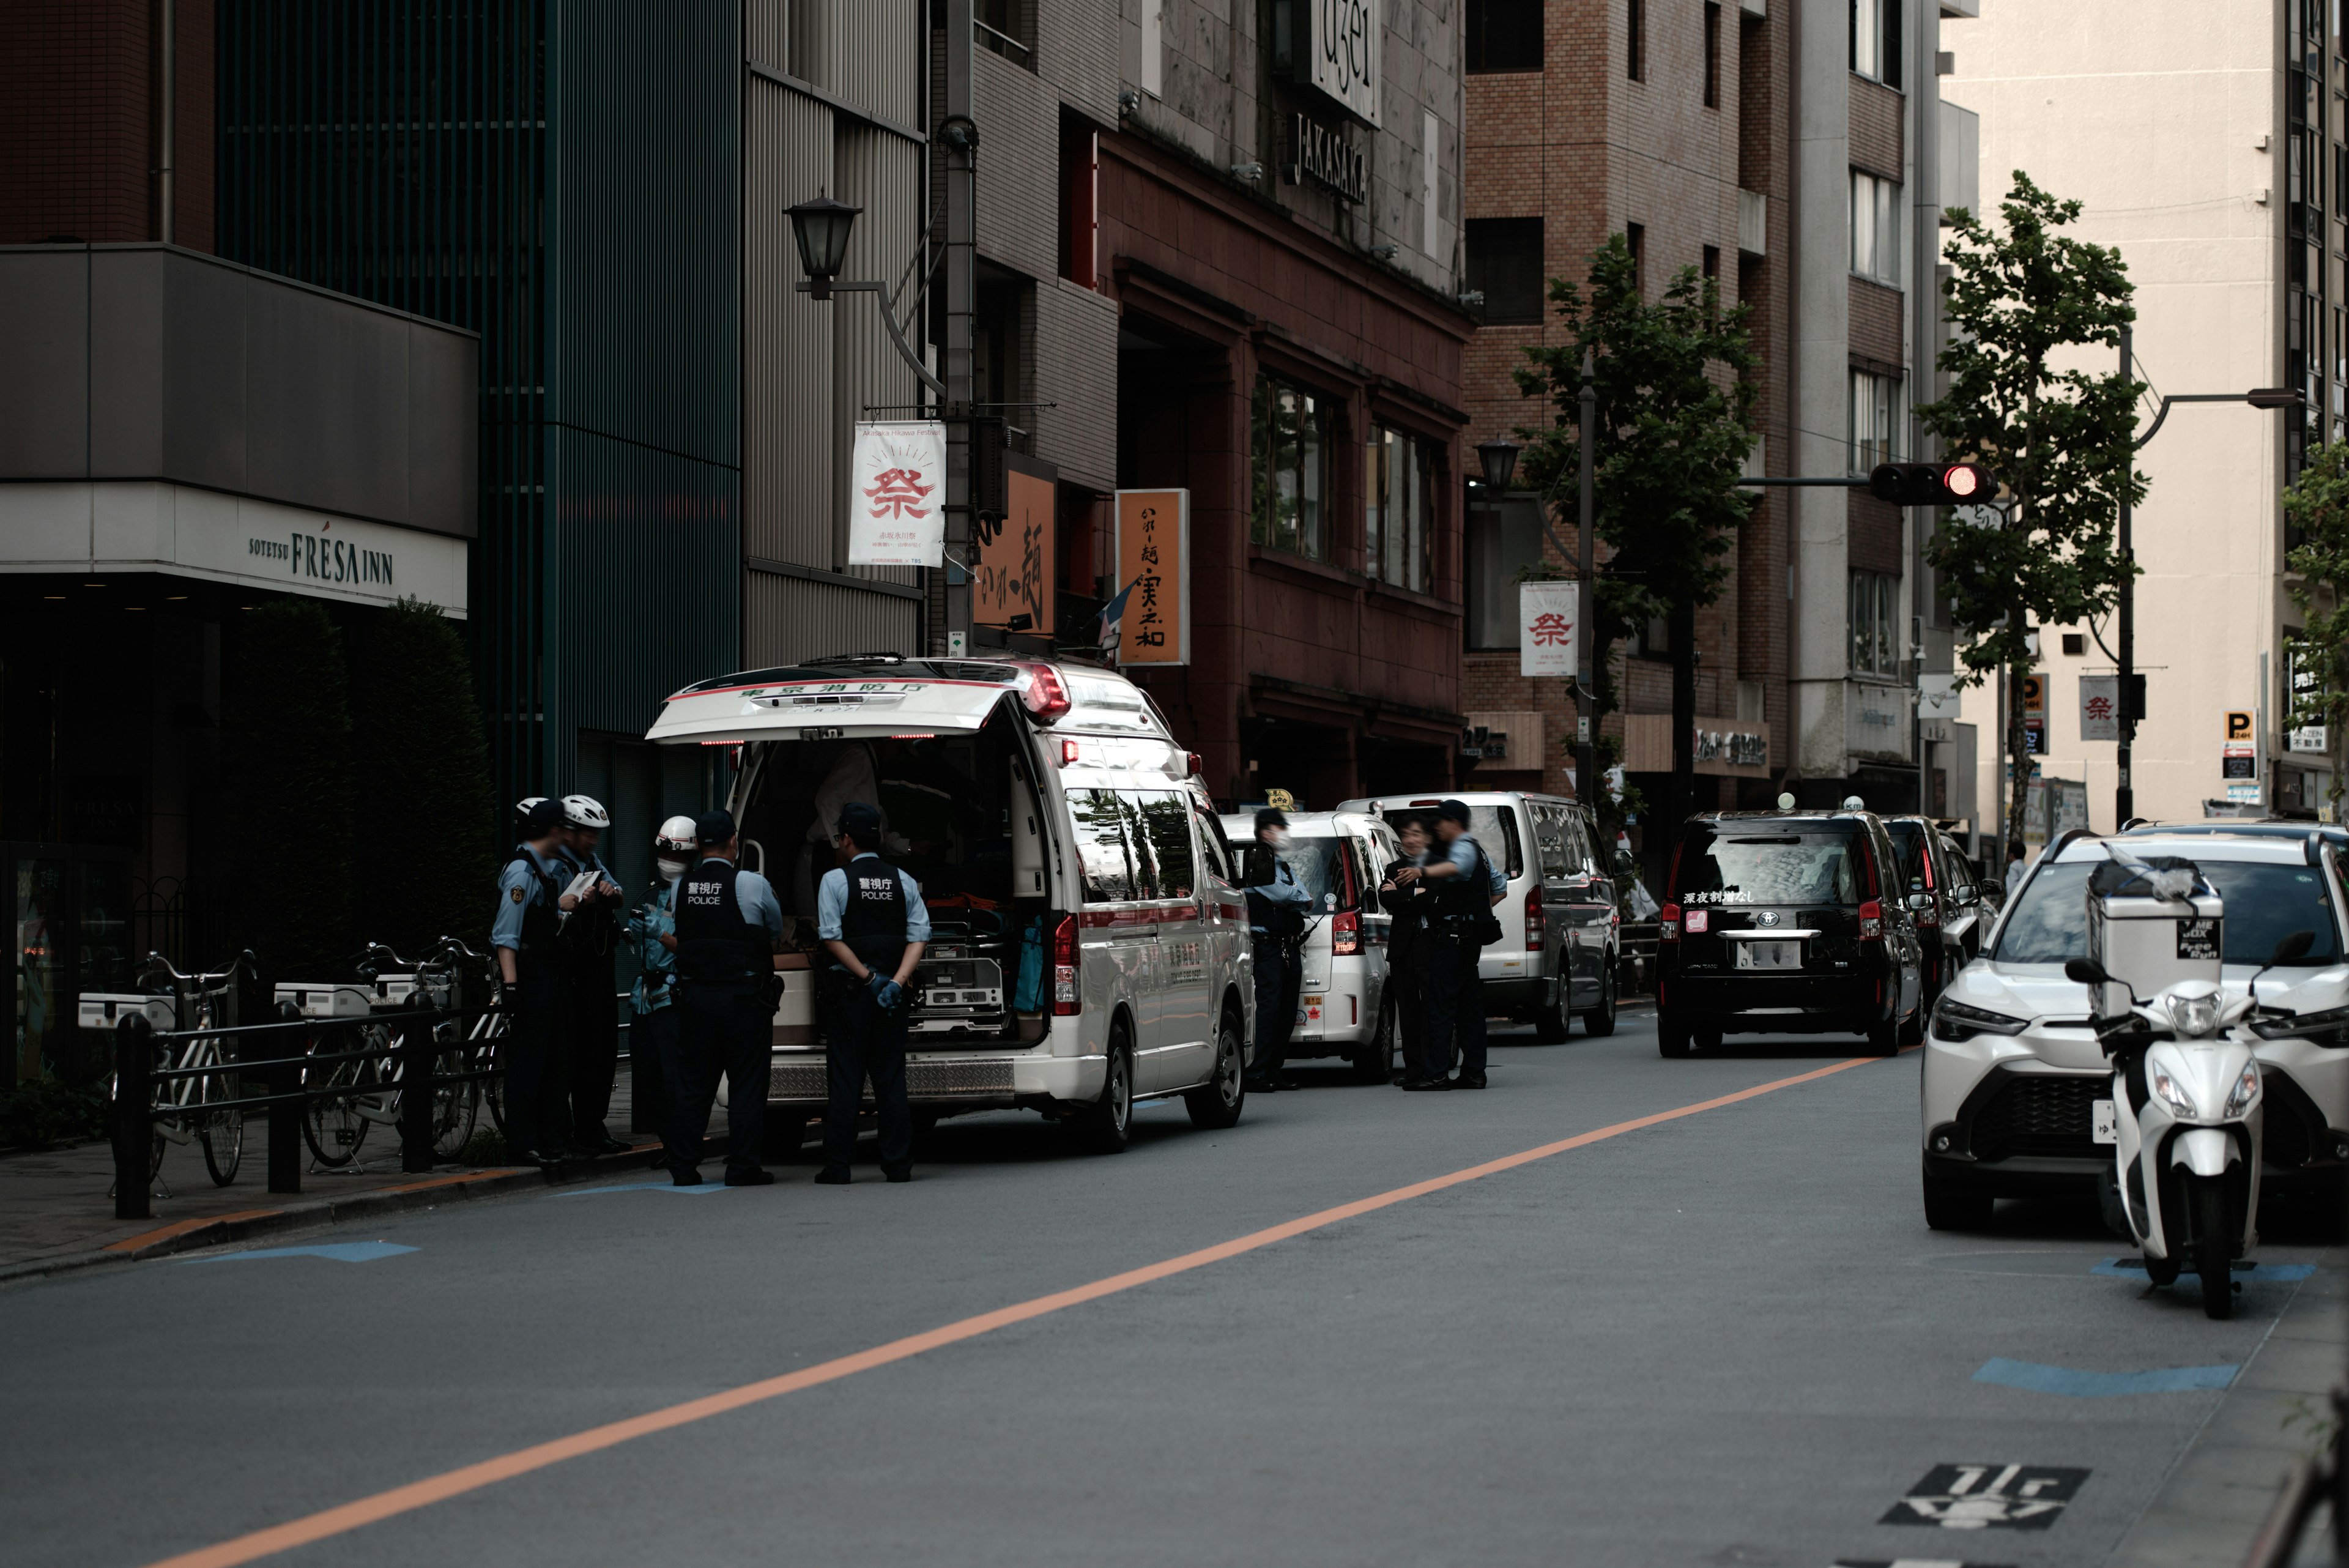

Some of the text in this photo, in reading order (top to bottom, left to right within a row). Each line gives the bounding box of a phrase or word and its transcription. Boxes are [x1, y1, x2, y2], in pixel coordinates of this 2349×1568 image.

[861, 468, 937, 521] 祭
[250, 521, 393, 585] SOTETSU FRÉSA INN
[1528, 613, 1575, 647] 祭
[738, 683, 929, 699] 東京消防庁
[2084, 696, 2114, 721] 祭
[2228, 713, 2250, 739] P
[2294, 738, 2323, 748] 不動産
[688, 882, 722, 895] 警視庁
[859, 877, 893, 891] 警視庁
[688, 896, 721, 905] POLICE
[861, 891, 893, 901] POLICE
[1683, 891, 1754, 904] 深夜割増なし
[1168, 943, 1200, 967] 東京消防庁
[2180, 943, 2213, 953] Free
[2191, 950, 2217, 960] Run
